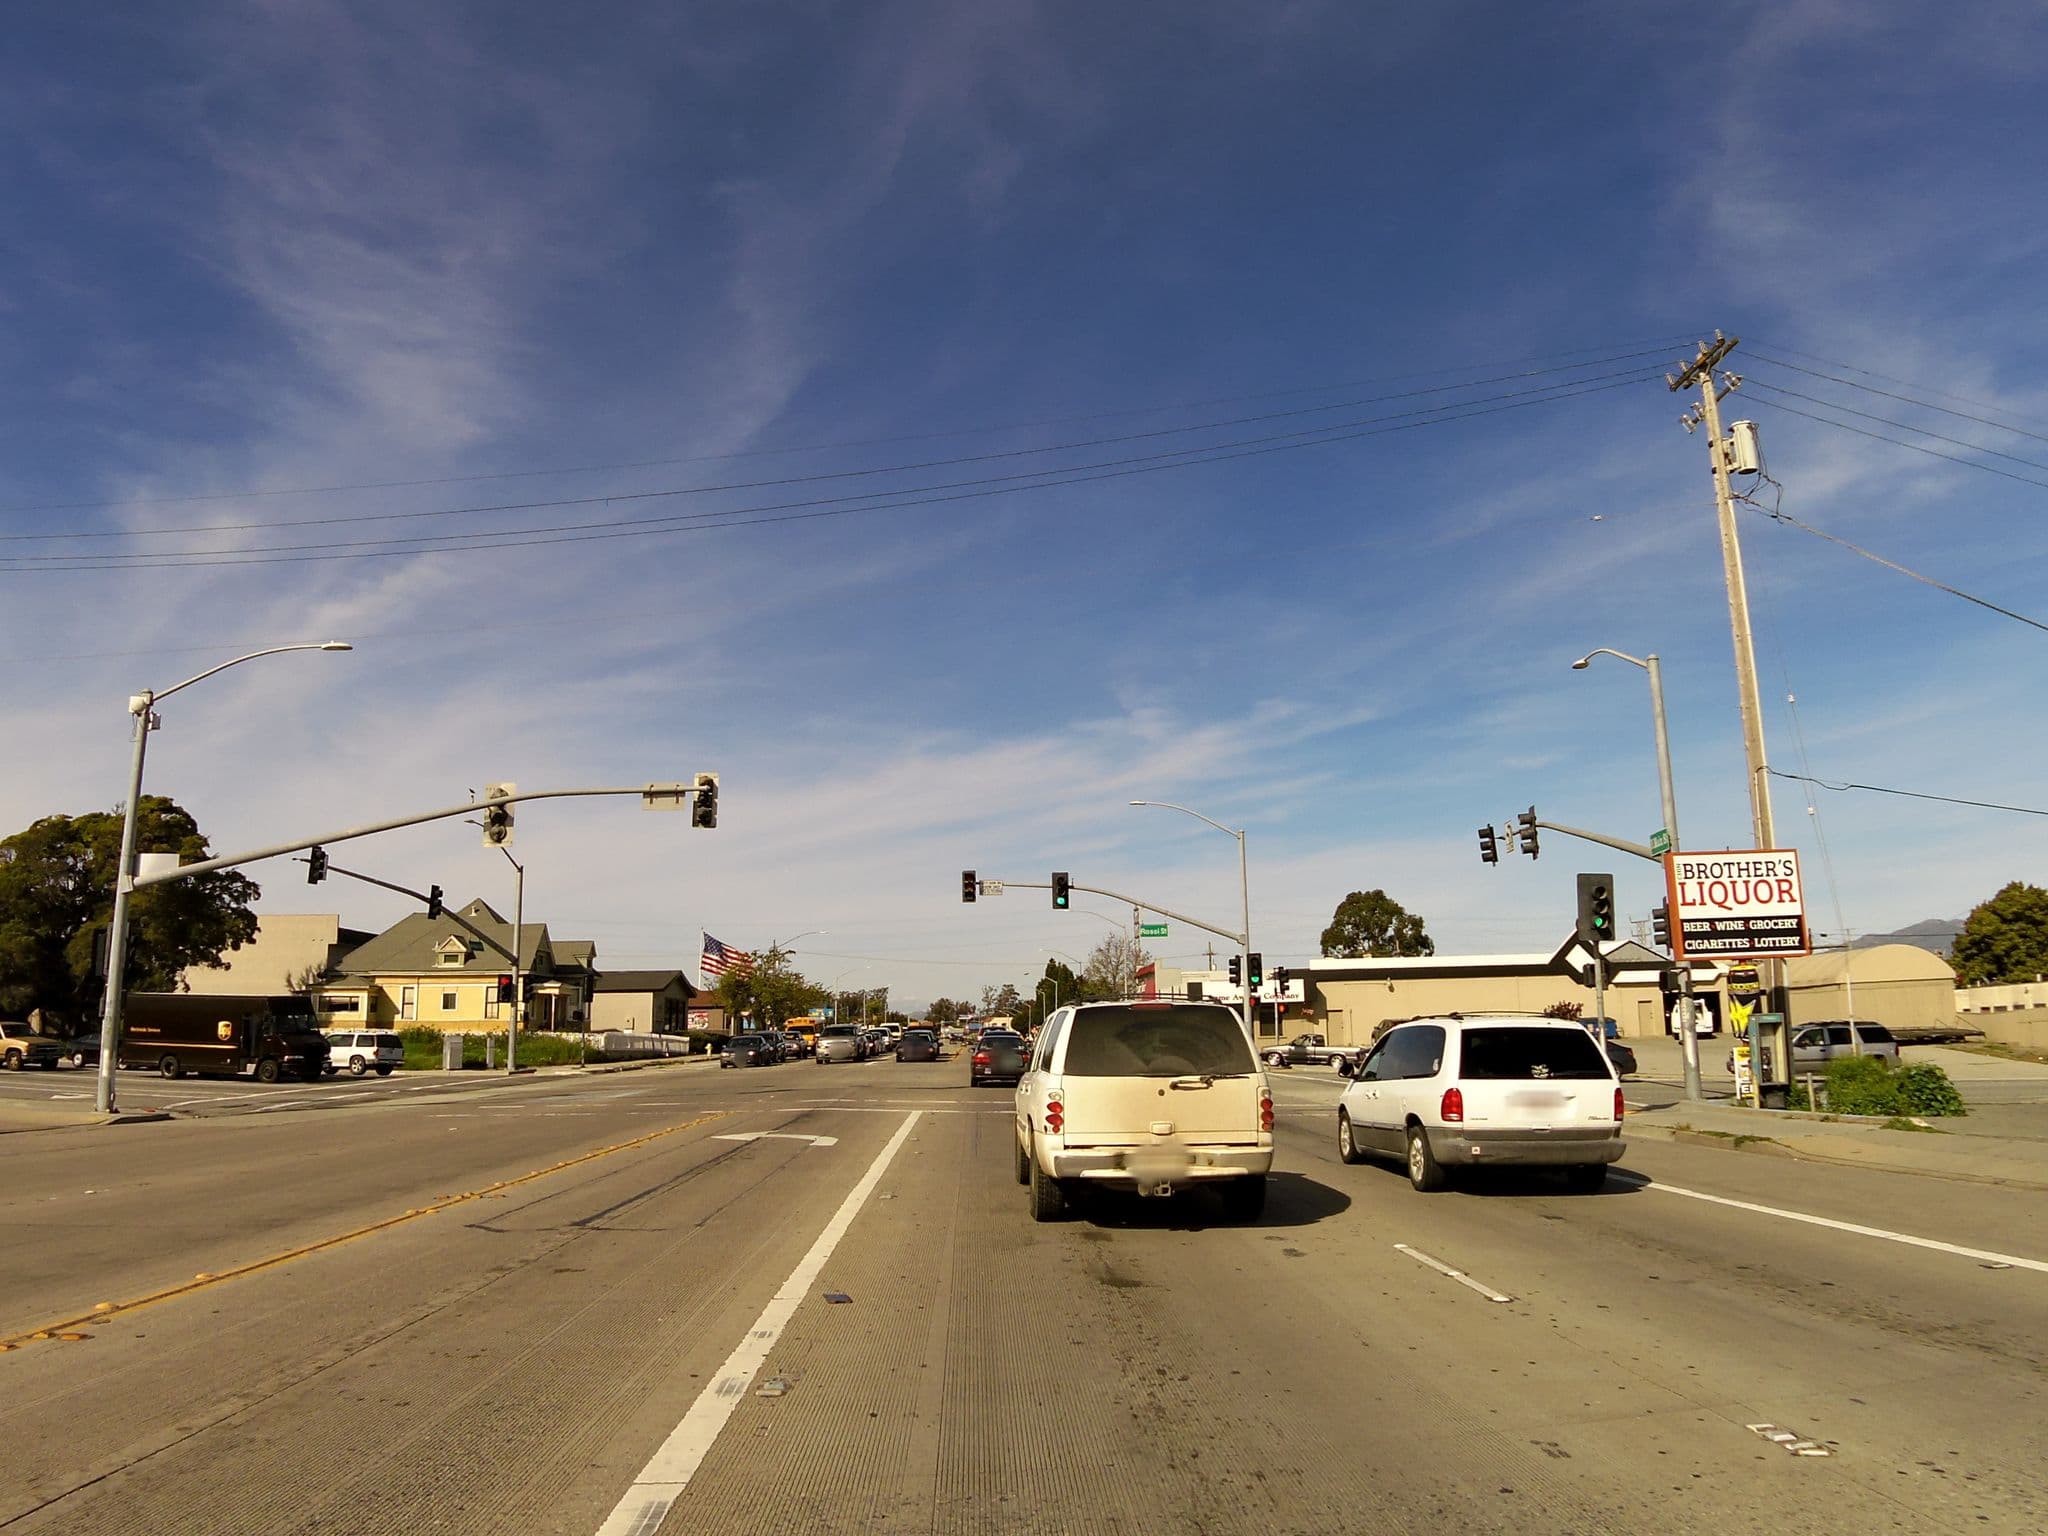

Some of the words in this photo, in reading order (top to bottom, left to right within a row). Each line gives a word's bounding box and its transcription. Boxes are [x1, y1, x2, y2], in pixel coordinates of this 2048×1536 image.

[1682, 860, 1794, 880] BROTHER'S
[1678, 879, 1797, 911] LIQUOR
[1683, 922, 1711, 932] BEER
[1715, 921, 1745, 931] WINE
[1749, 919, 1798, 930] GROCERY
[1684, 938, 1750, 950] CIGARETTES
[1754, 937, 1800, 947] LOTTERY
